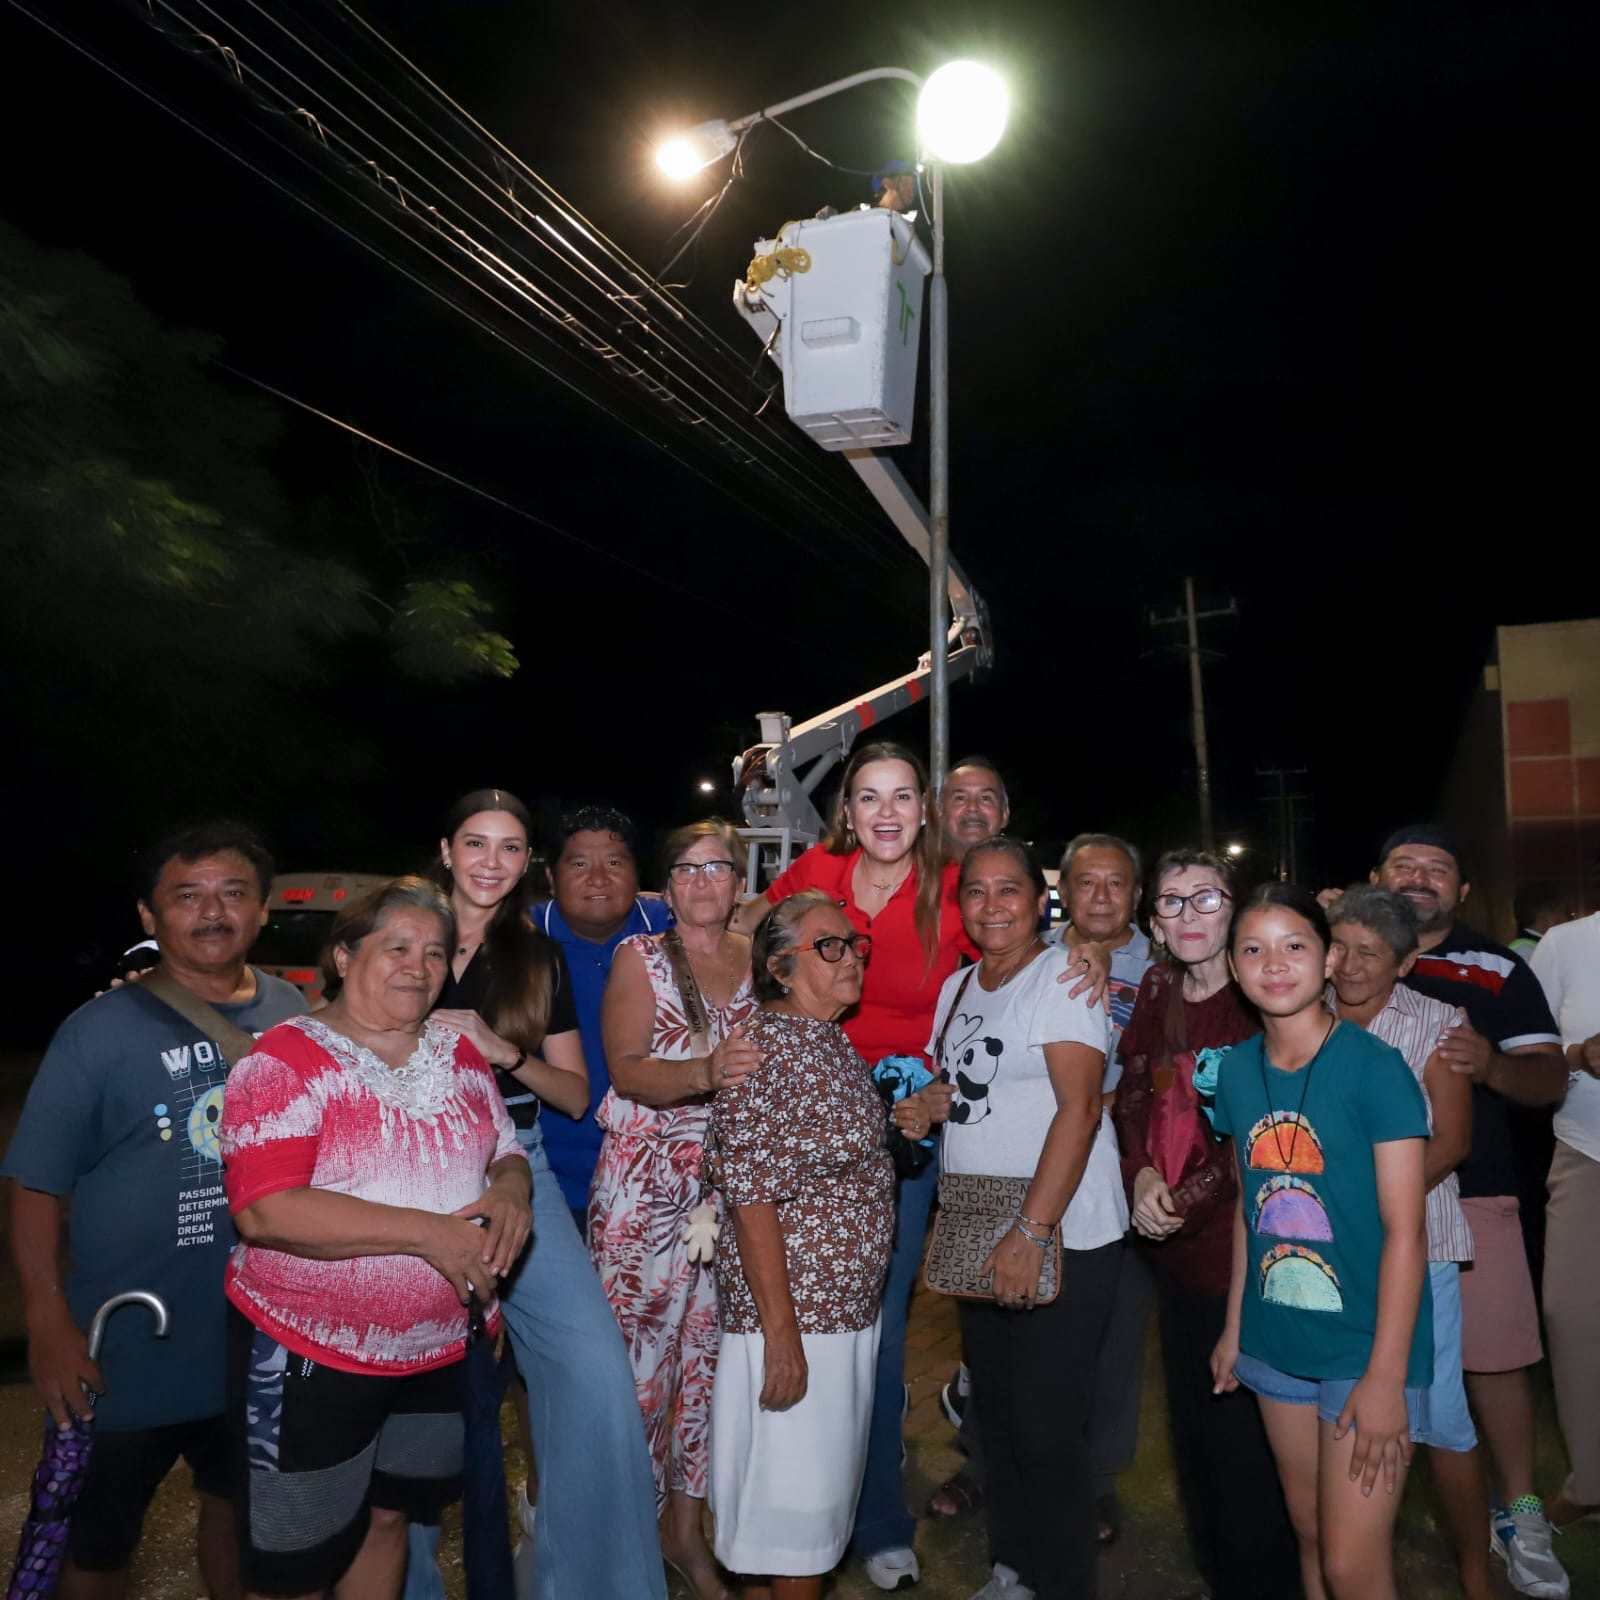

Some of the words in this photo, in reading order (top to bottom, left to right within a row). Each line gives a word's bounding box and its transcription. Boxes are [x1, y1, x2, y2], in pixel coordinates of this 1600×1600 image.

[179, 1185, 223, 1201] PASSION
[976, 1178, 1003, 1192] CLN
[178, 1196, 229, 1213] DETERMIN
[956, 1190, 980, 1204] CLN
[995, 1195, 1022, 1209] CLN
[178, 1211, 212, 1224] SPIRIT
[937, 1211, 949, 1237] CLN
[959, 1213, 972, 1239] CLN
[177, 1223, 214, 1236] DREAM
[983, 1215, 998, 1242] CLN
[176, 1234, 214, 1247] ACTION
[943, 1231, 957, 1260] CLN
[967, 1233, 982, 1263] CLN
[928, 1255, 942, 1283] CLN
[952, 1257, 965, 1287] CLN
